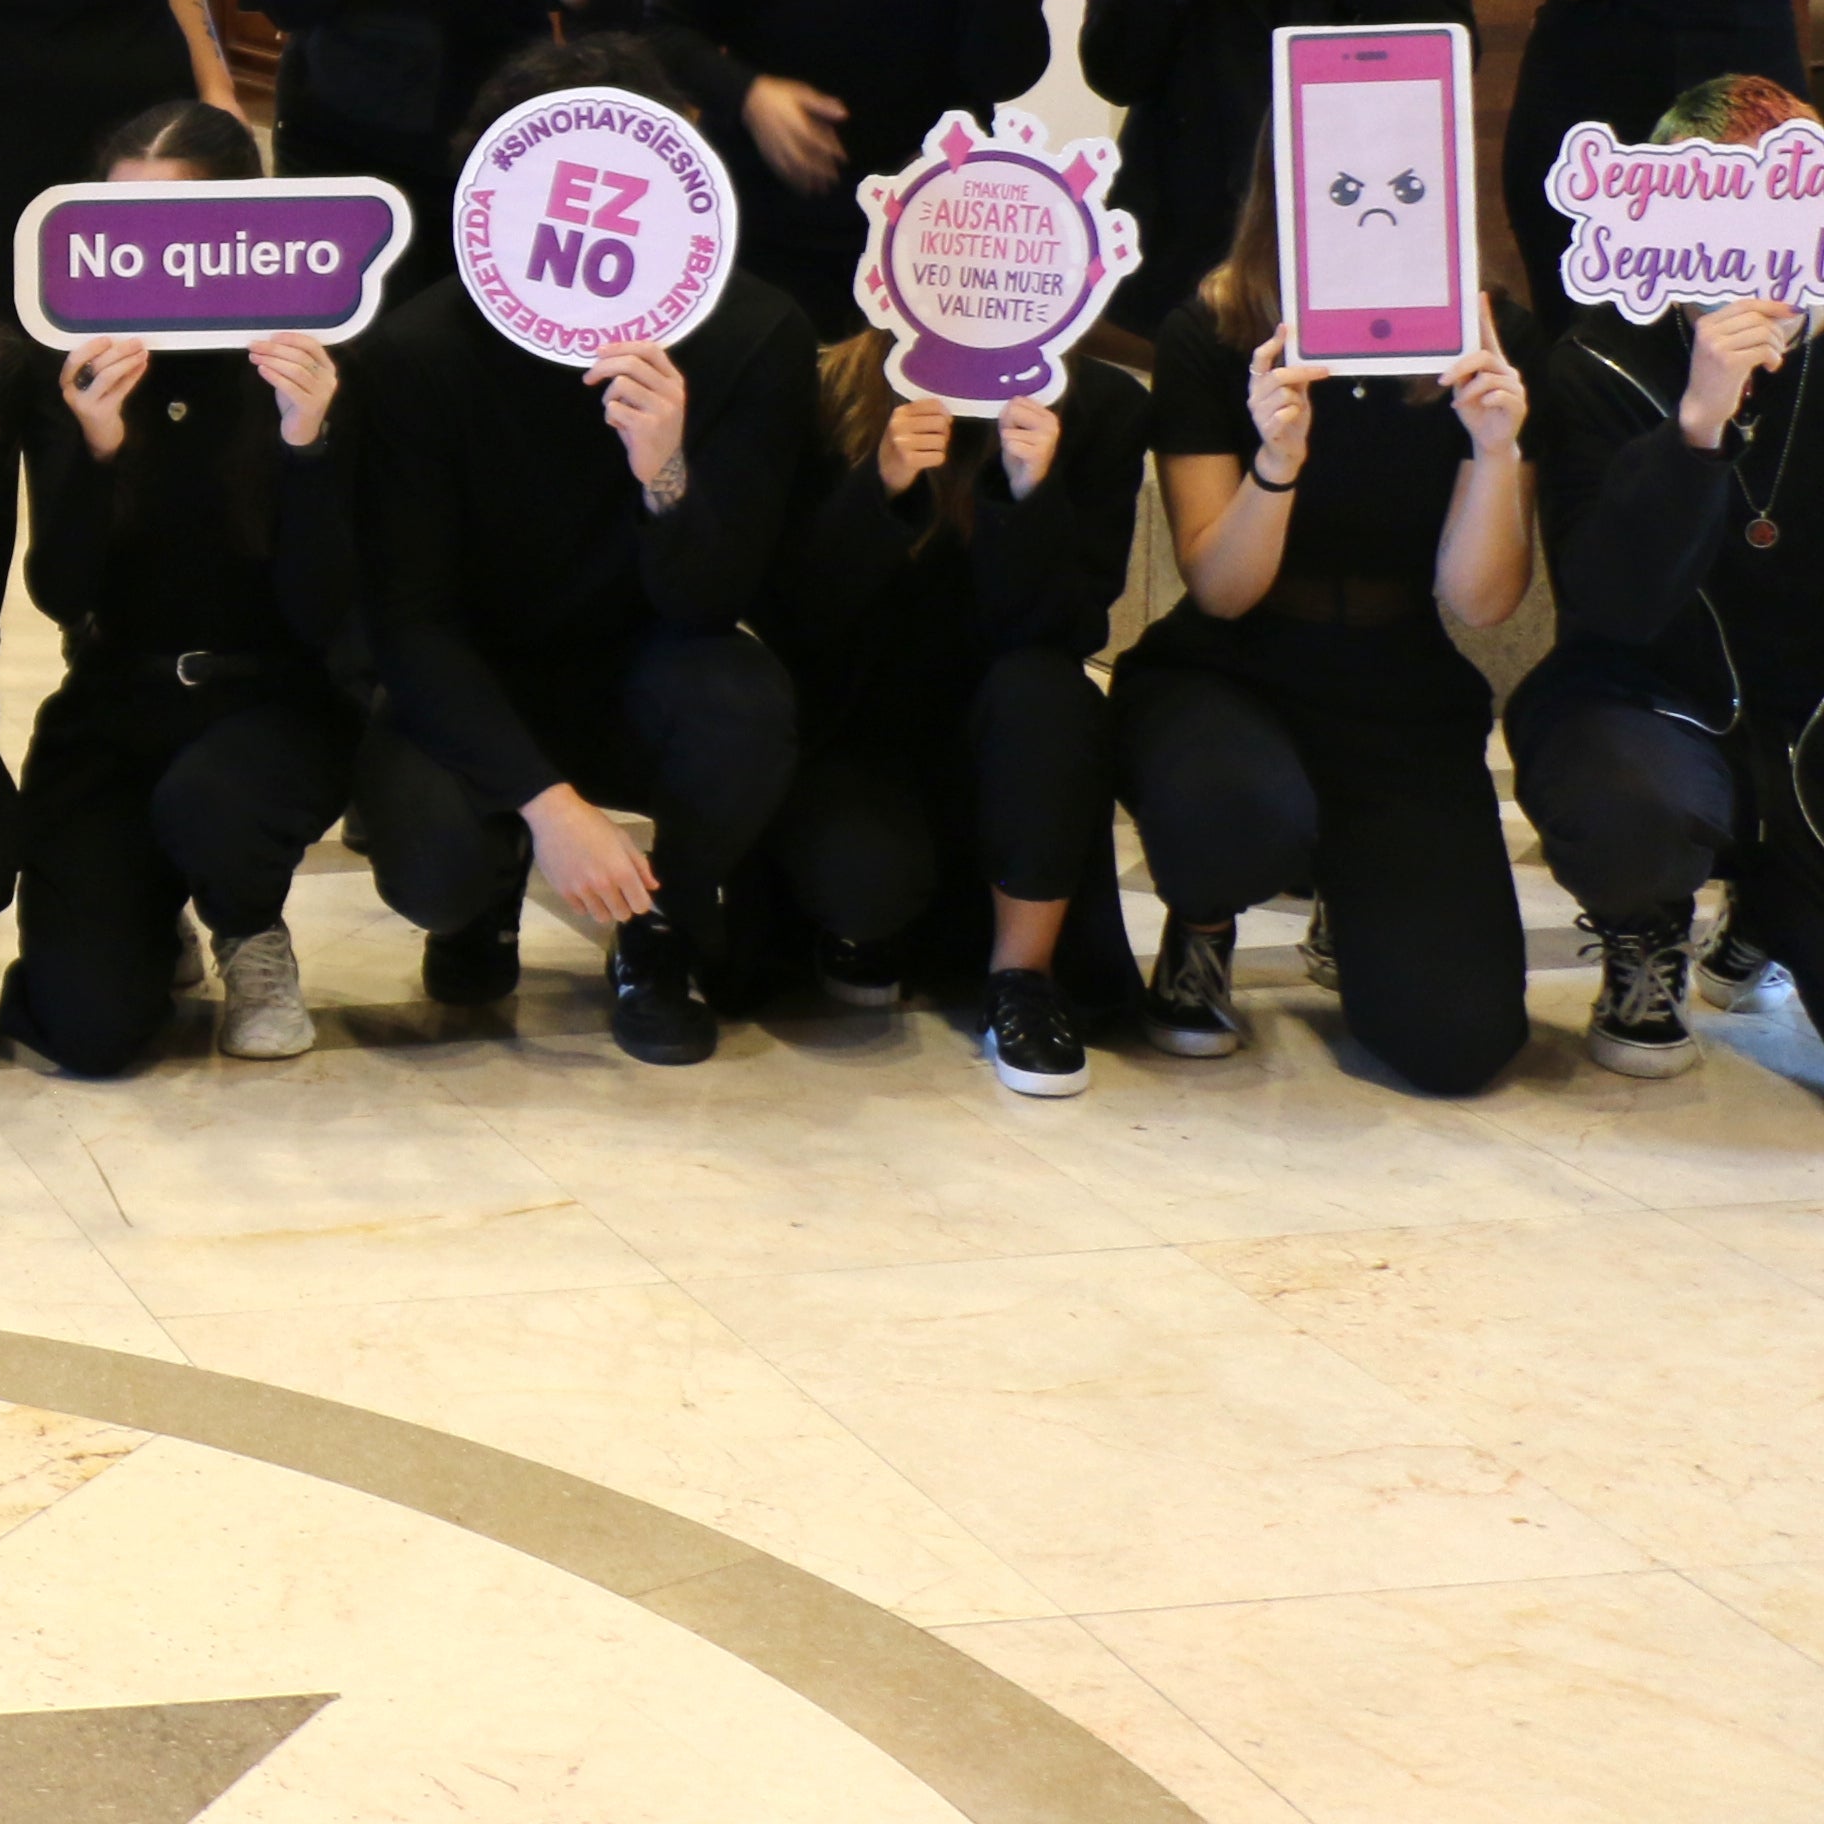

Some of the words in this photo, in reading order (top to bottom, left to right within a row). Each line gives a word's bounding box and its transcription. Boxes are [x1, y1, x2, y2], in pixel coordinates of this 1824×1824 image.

[545, 159, 650, 237] EZ
[962, 180, 1030, 201] EMAKUME
[1569, 140, 1754, 221] Seguru
[934, 199, 1054, 236] AUSARTA
[68, 233, 144, 278] No
[162, 230, 340, 288] quiero
[525, 222, 635, 298] NO
[920, 231, 1007, 260] IKUSTEN
[1015, 239, 1061, 265] DUT
[1582, 226, 1756, 301] Segura
[1766, 248, 1803, 302] y
[913, 263, 950, 287] VEO
[960, 267, 998, 290] UNA
[1005, 270, 1064, 296] MUJER
[938, 293, 1034, 323] VALIENTE
